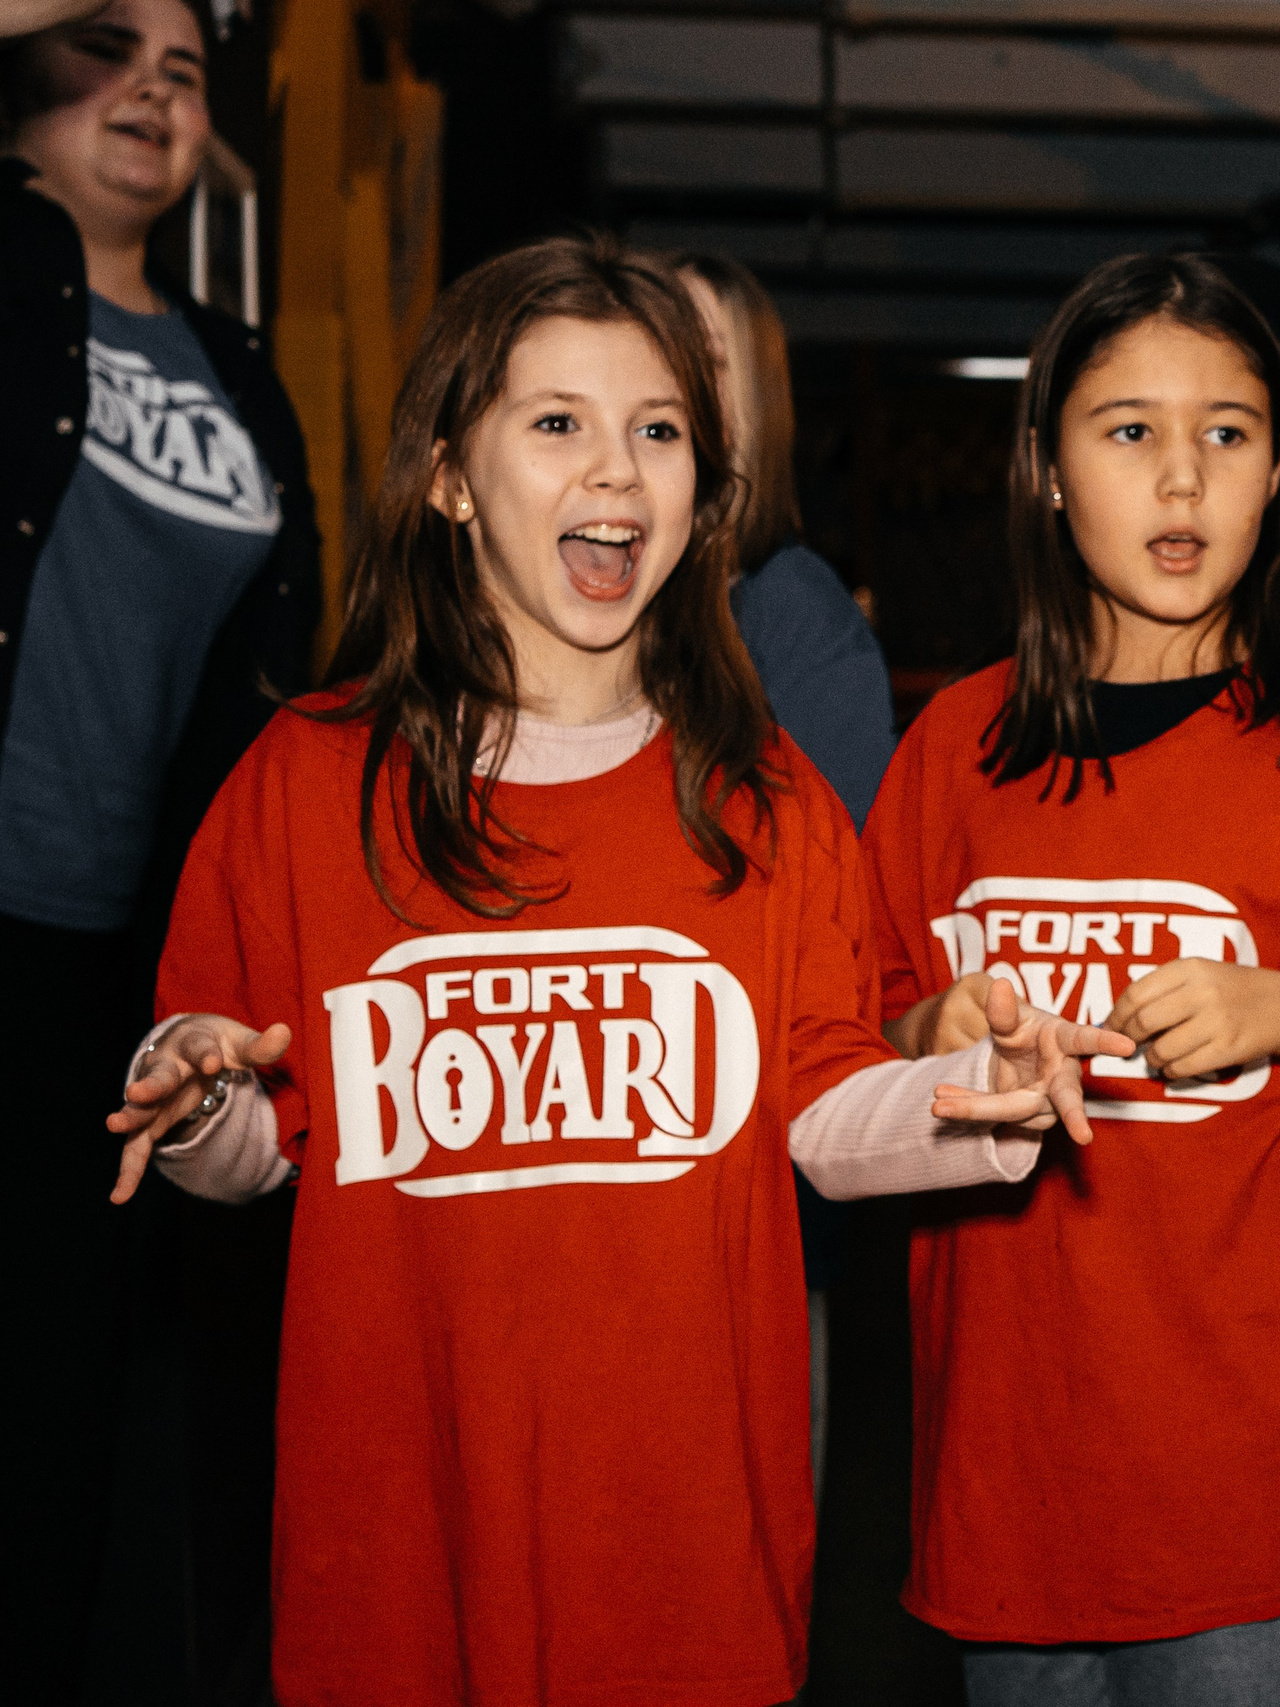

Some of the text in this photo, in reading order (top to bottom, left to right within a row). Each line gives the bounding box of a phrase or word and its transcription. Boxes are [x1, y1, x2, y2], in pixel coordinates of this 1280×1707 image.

[984, 909, 1167, 957] FORT
[425, 962, 638, 1020] FORT
[322, 961, 761, 1187] BOYARD
